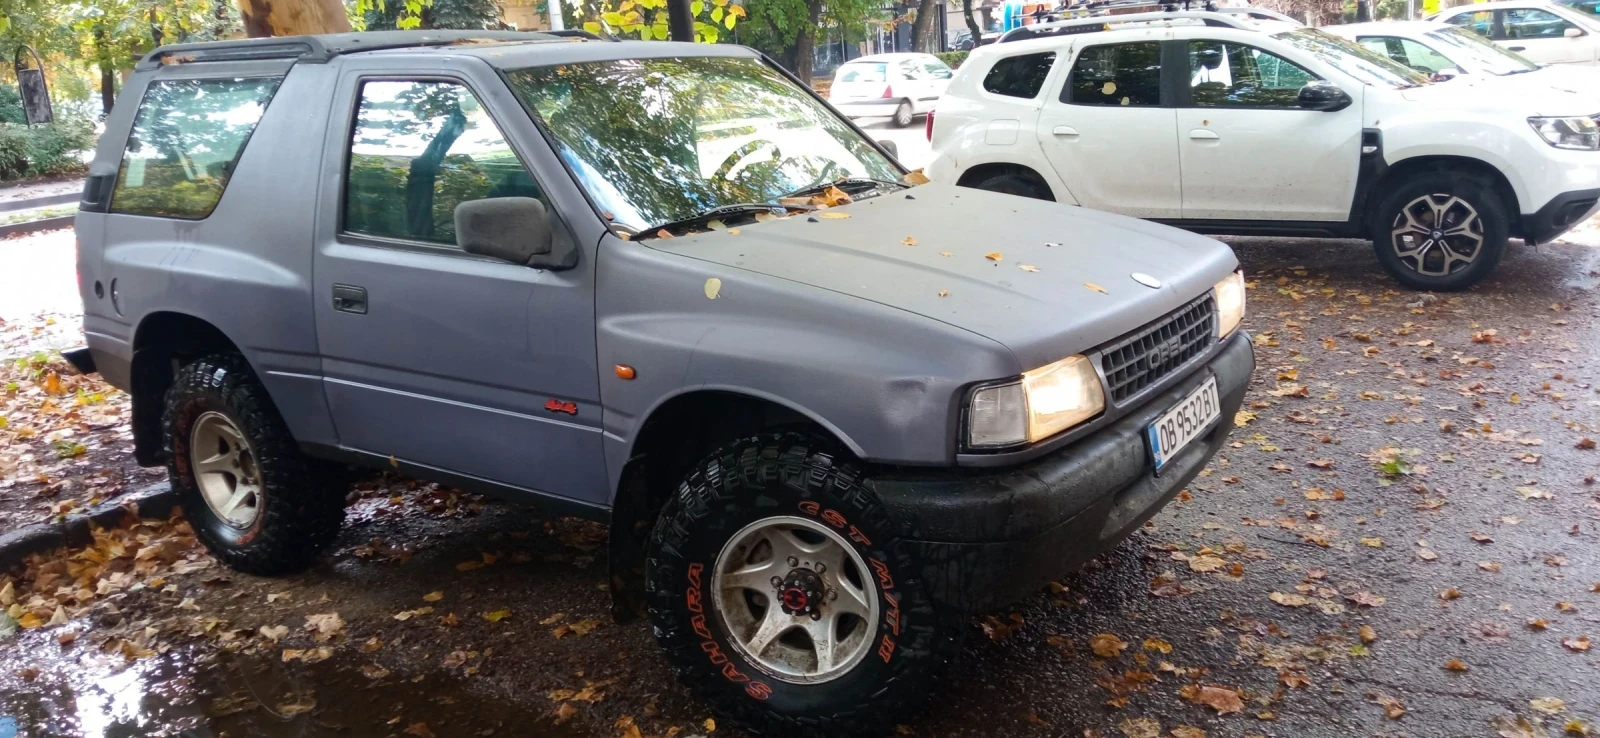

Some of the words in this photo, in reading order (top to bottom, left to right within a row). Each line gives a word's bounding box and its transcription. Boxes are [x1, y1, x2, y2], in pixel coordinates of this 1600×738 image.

[1149, 336, 1184, 368] OPEL
[1160, 419, 1177, 455] OB
[1176, 398, 1204, 440] 9532
[1203, 383, 1216, 418] BT
[798, 501, 871, 546] CST
[687, 563, 772, 700] SAHARA
